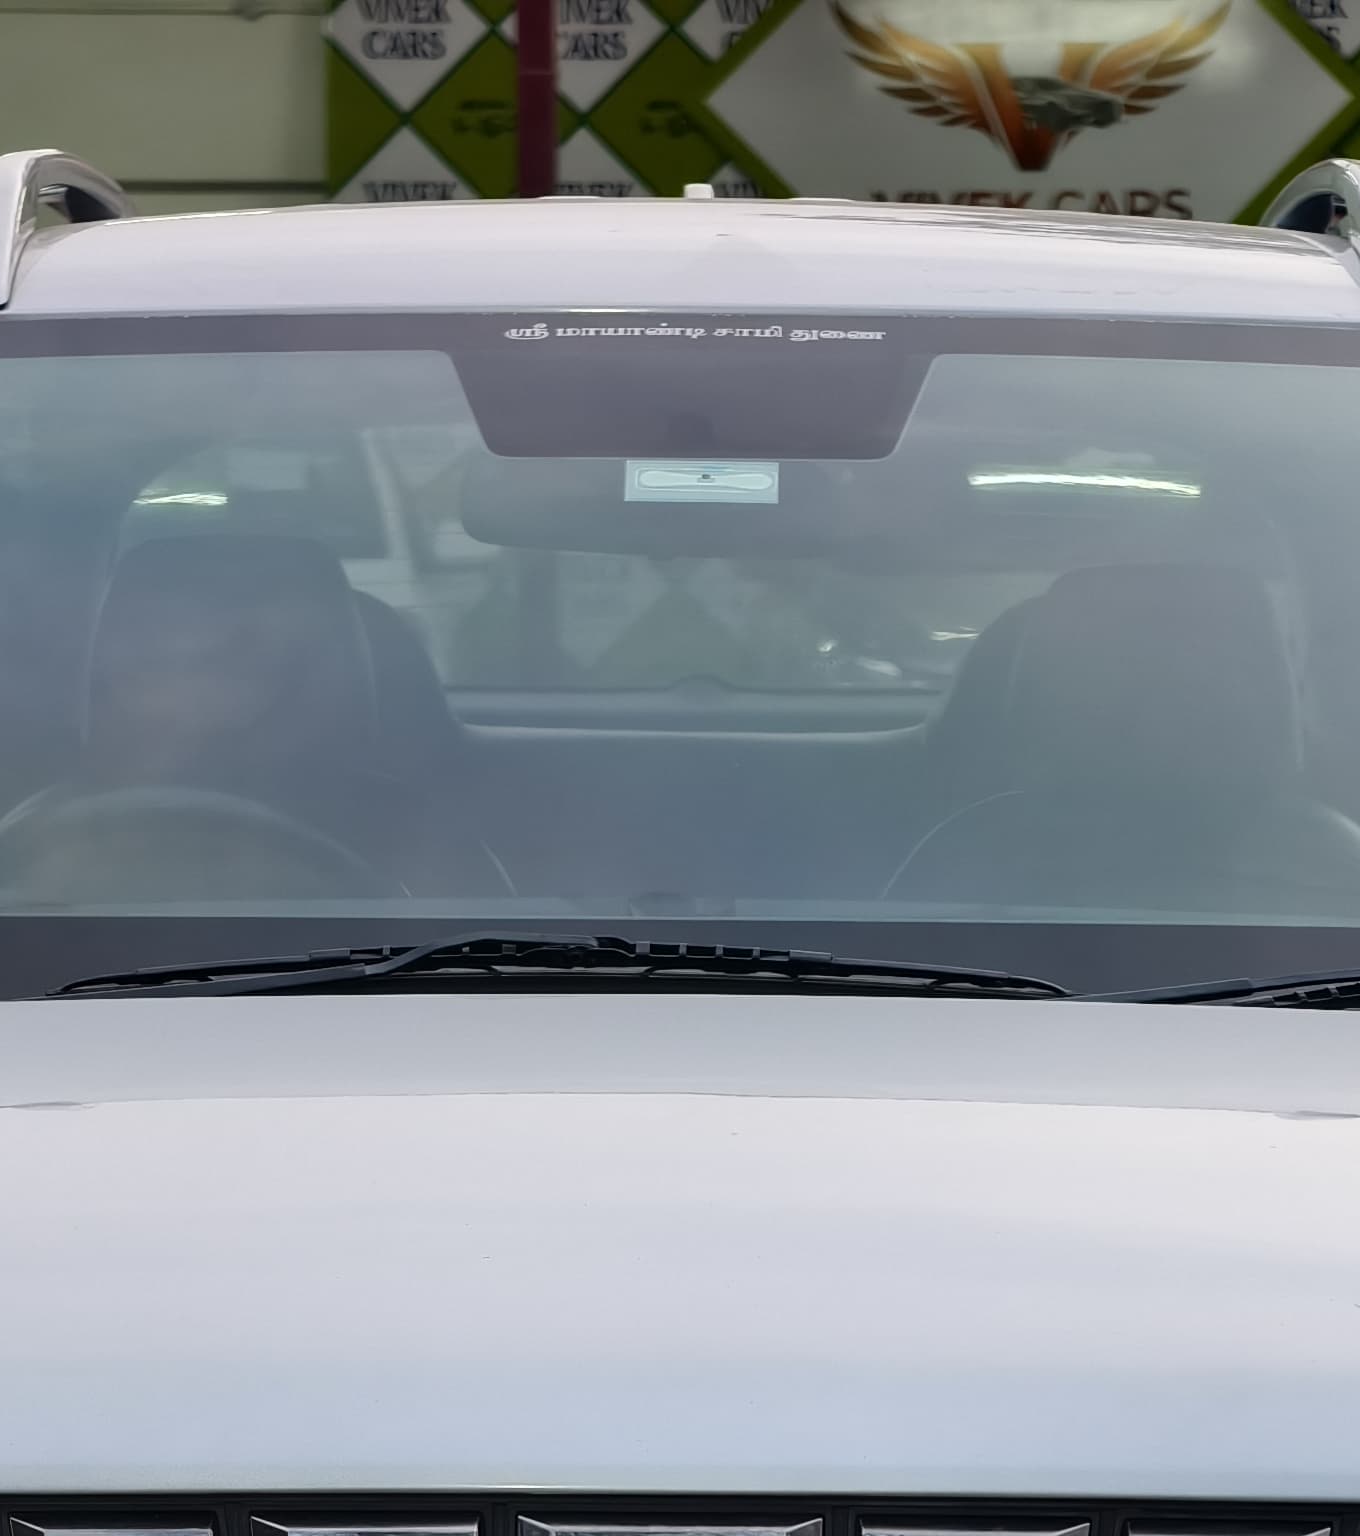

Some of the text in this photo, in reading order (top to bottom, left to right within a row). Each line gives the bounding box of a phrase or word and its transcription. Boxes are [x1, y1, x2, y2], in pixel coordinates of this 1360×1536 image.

[559, 0, 633, 25] IVEK
[361, 29, 447, 60] CARS
[558, 31, 628, 61] ARS
